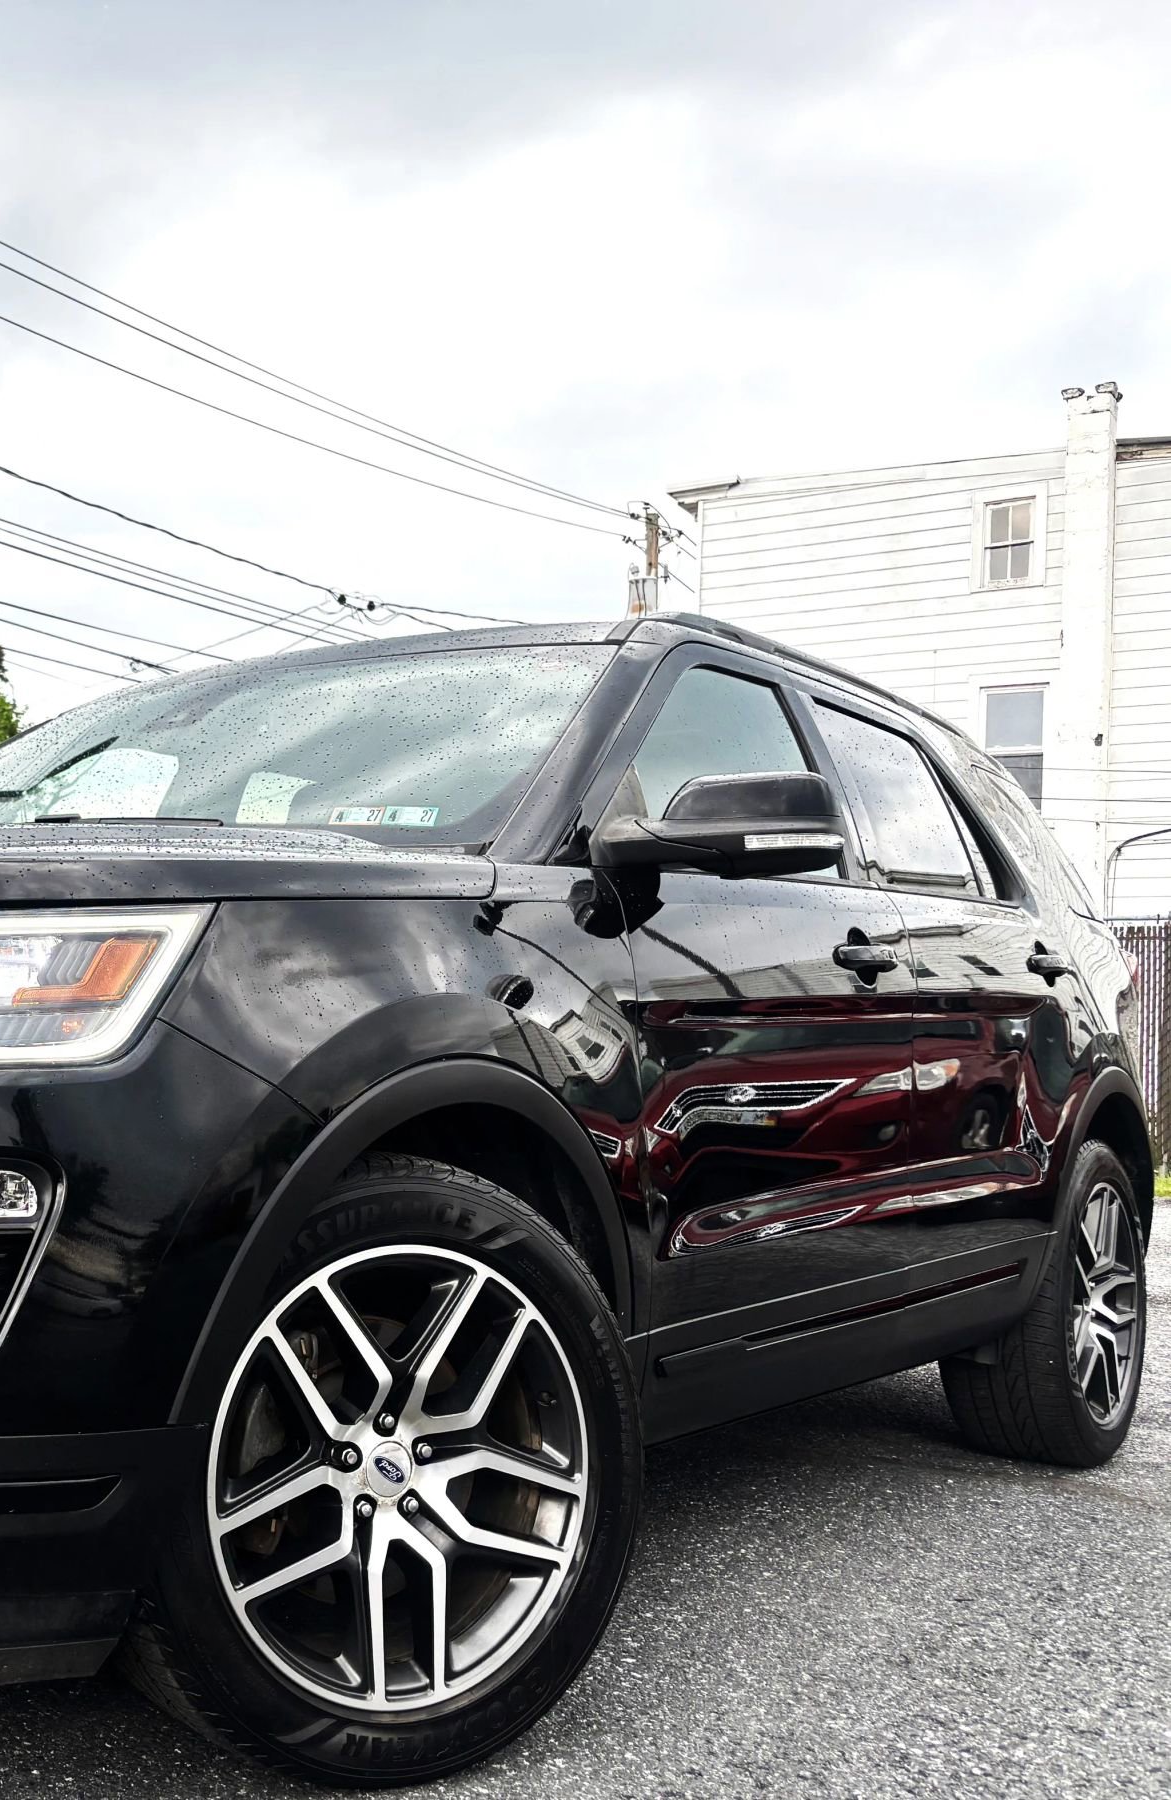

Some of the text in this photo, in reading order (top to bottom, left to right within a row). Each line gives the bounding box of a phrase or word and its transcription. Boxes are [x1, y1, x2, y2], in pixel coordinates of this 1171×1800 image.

[367, 809, 381, 822] 27
[420, 809, 434, 823] 27
[378, 1459, 402, 1481] Ford
